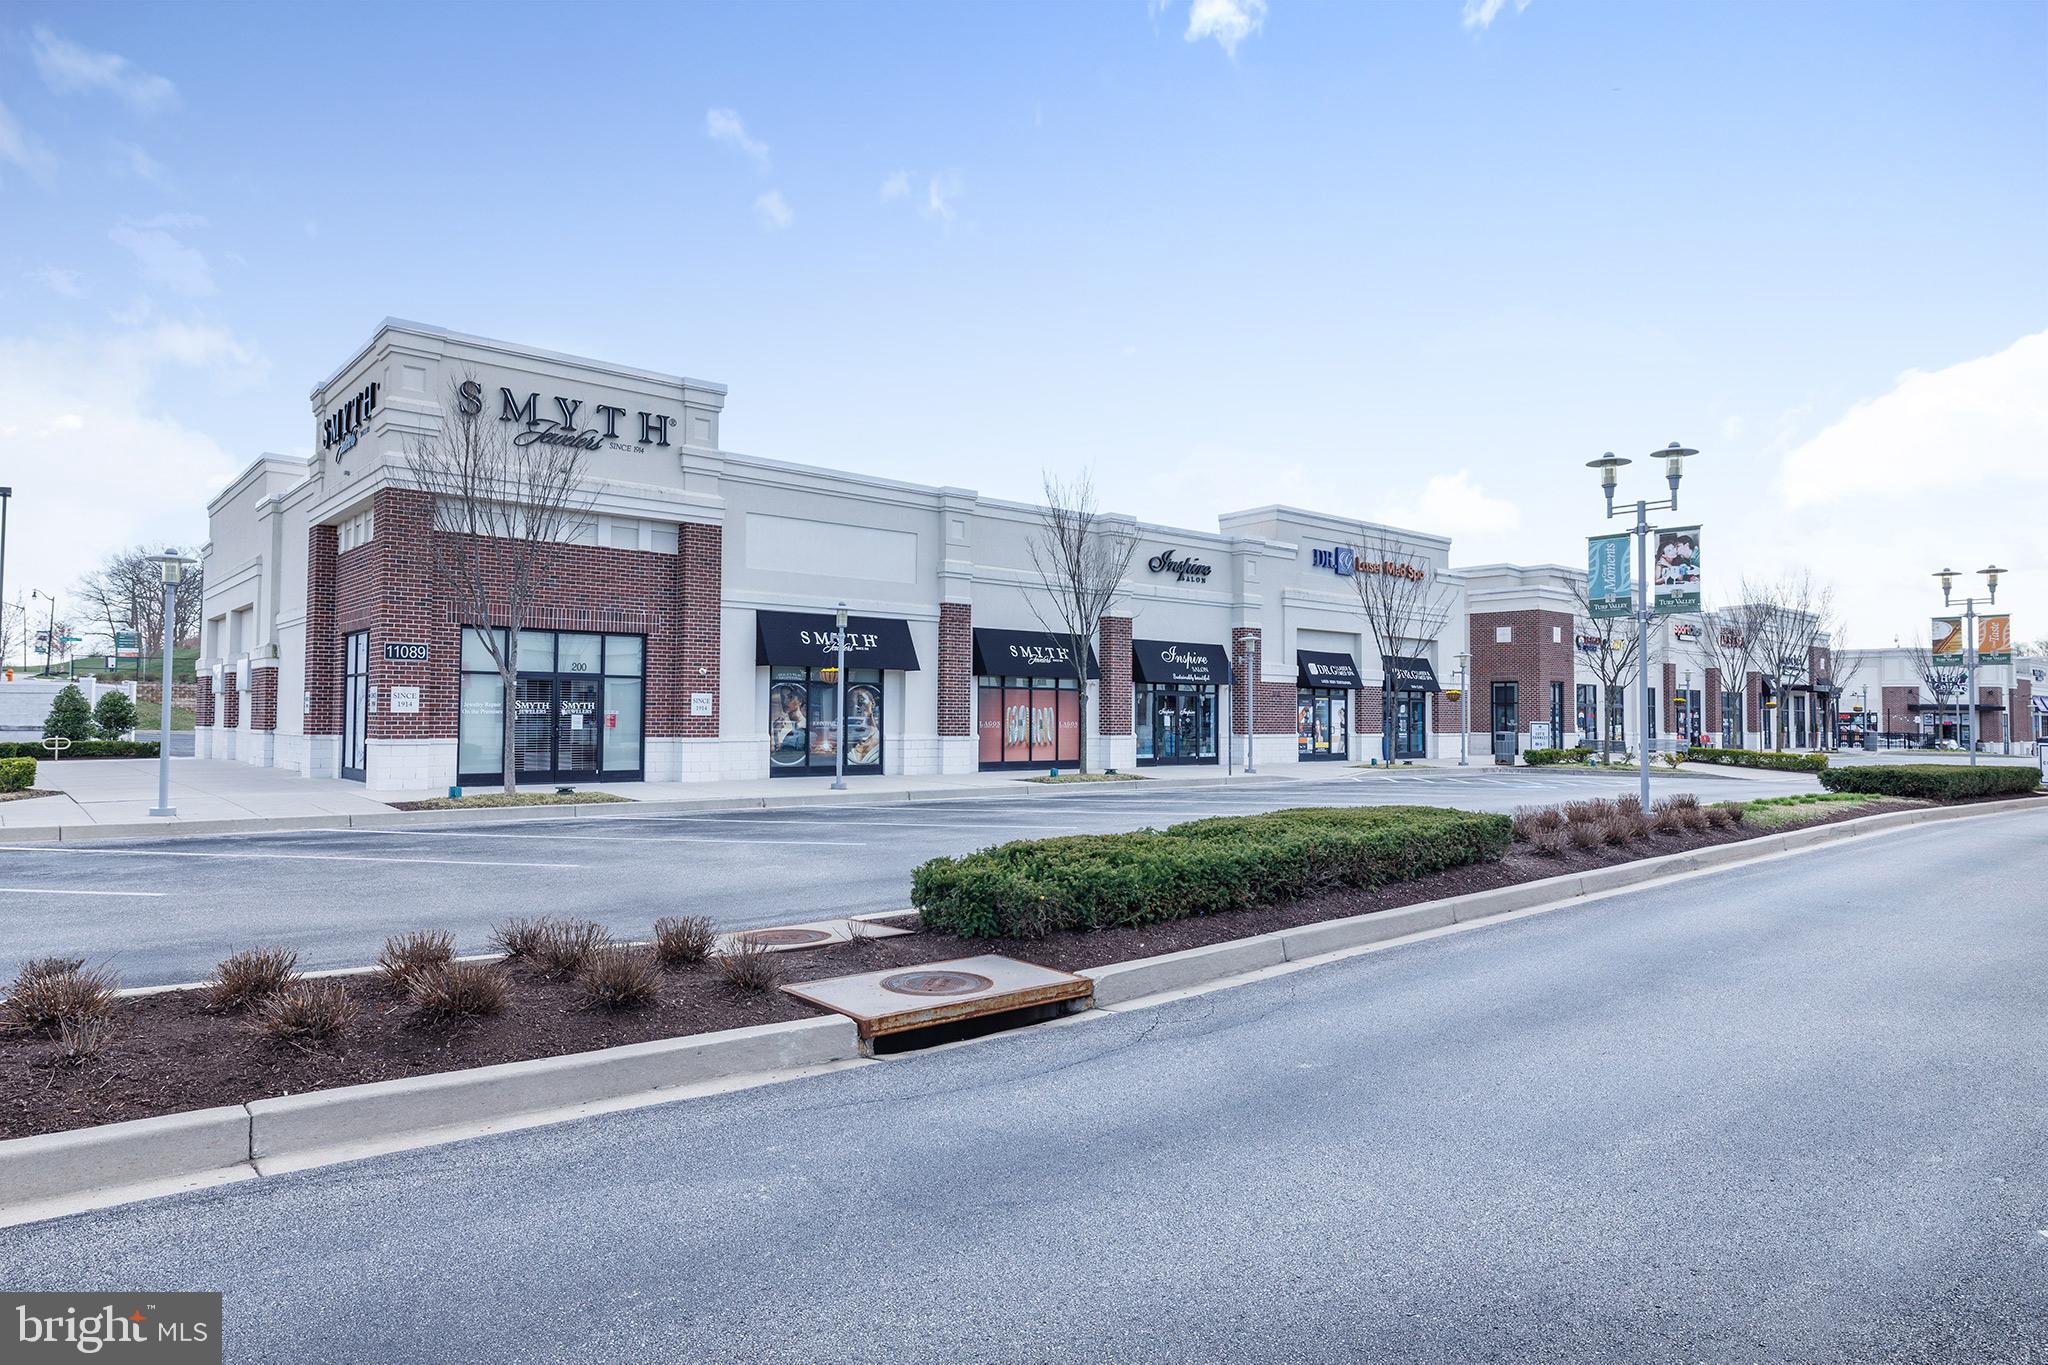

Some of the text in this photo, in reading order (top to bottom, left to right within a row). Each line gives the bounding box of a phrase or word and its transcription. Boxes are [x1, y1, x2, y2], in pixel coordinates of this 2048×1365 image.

[513, 418, 604, 451] Jewelers
[609, 441, 632, 452] SINCE
[1148, 549, 1212, 581] Inspire
[386, 645, 426, 659] 11089
[1161, 645, 1208, 670] Inspire
[571, 662, 588, 672] 200
[393, 692, 418, 700] SINCE
[514, 700, 550, 710] SMYTH
[562, 700, 595, 710] SMYTH
